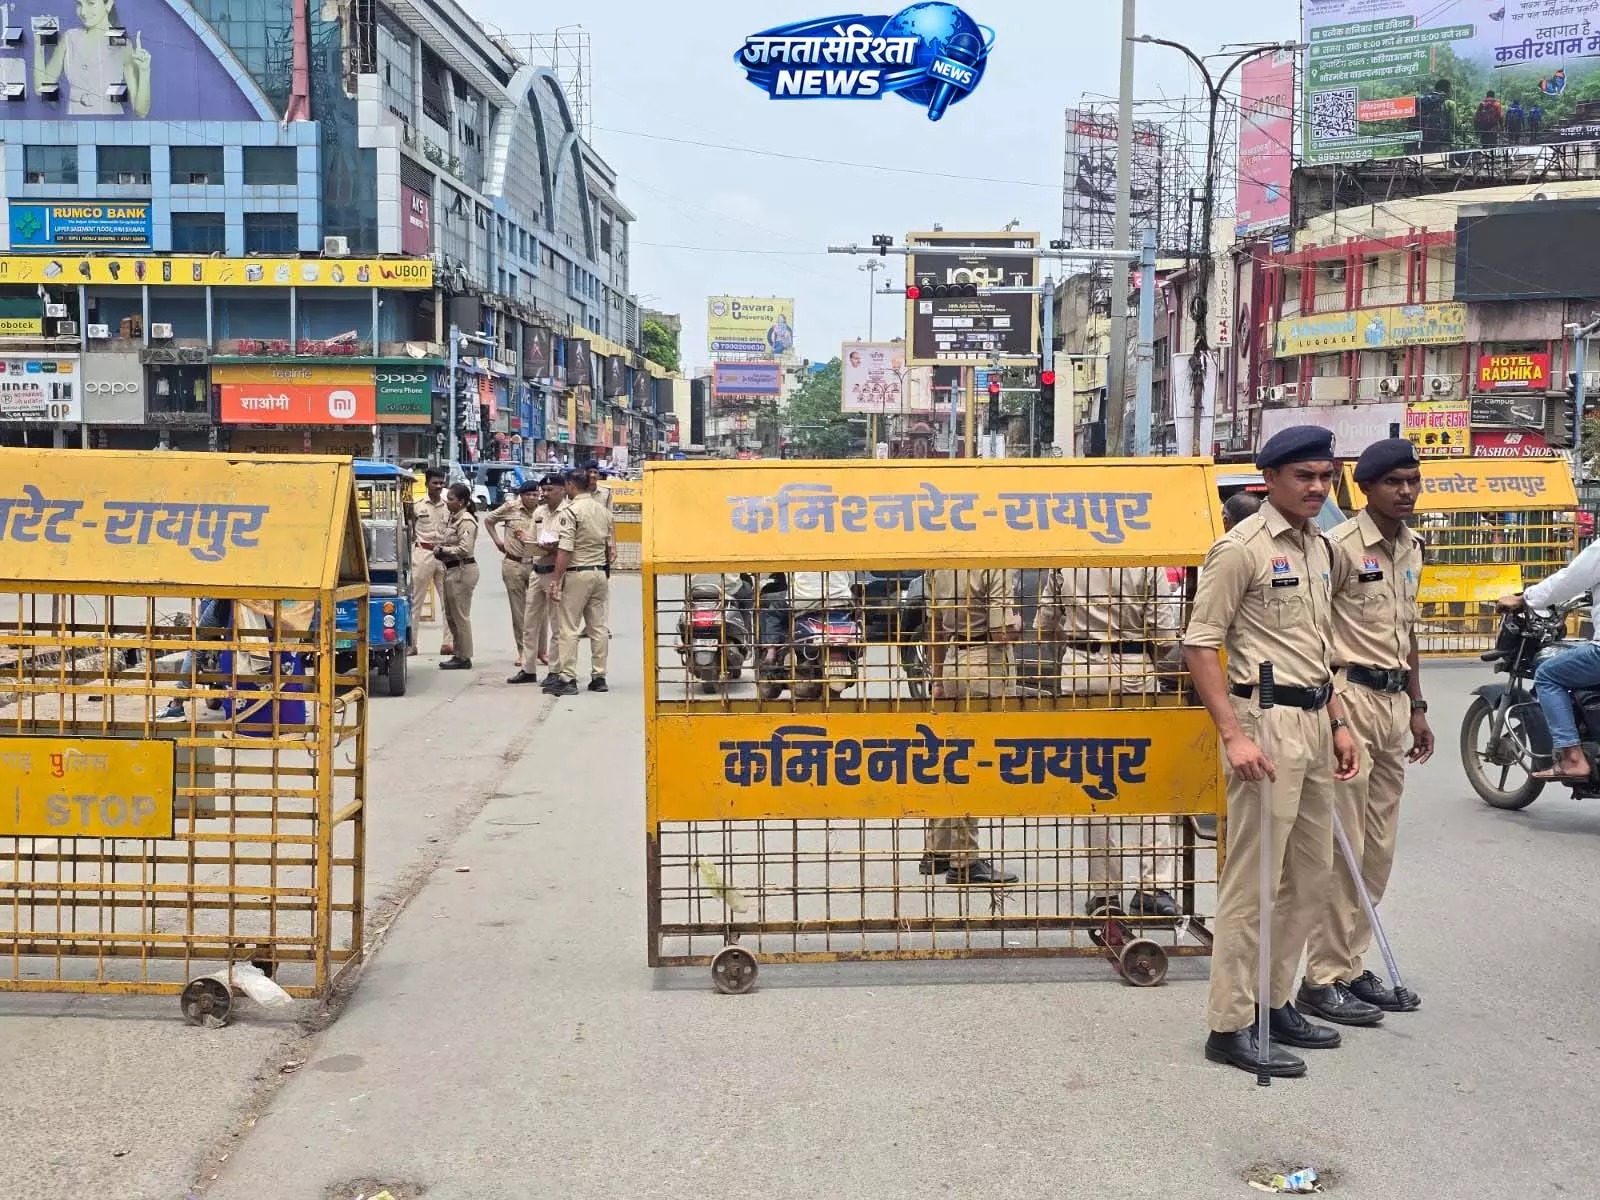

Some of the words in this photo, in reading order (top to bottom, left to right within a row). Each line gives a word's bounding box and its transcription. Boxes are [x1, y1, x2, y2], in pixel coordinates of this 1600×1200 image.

[1536, 23, 1580, 39] स्वागत
[1581, 19, 1591, 36] है
[1494, 37, 1583, 62] कबीरधाम
[53, 207, 102, 218] RUMCO
[107, 208, 146, 219] BANK
[395, 265, 427, 278] UBON
[731, 301, 774, 312] Davara
[733, 312, 774, 322] University
[1299, 335, 1357, 348] LUGGAGE
[1491, 356, 1534, 366] HOTEL
[376, 373, 428, 384] oppo
[1481, 366, 1543, 382] RADHIKA
[85, 381, 139, 396] oppo
[240, 393, 290, 411] शाओमी
[1474, 445, 1521, 457] FASHION
[727, 482, 1153, 545] कमिश्नरेट-रायपुर
[720, 723, 1151, 801] कमिश्नरेट-रायपुर
[45, 794, 156, 828] STOP
